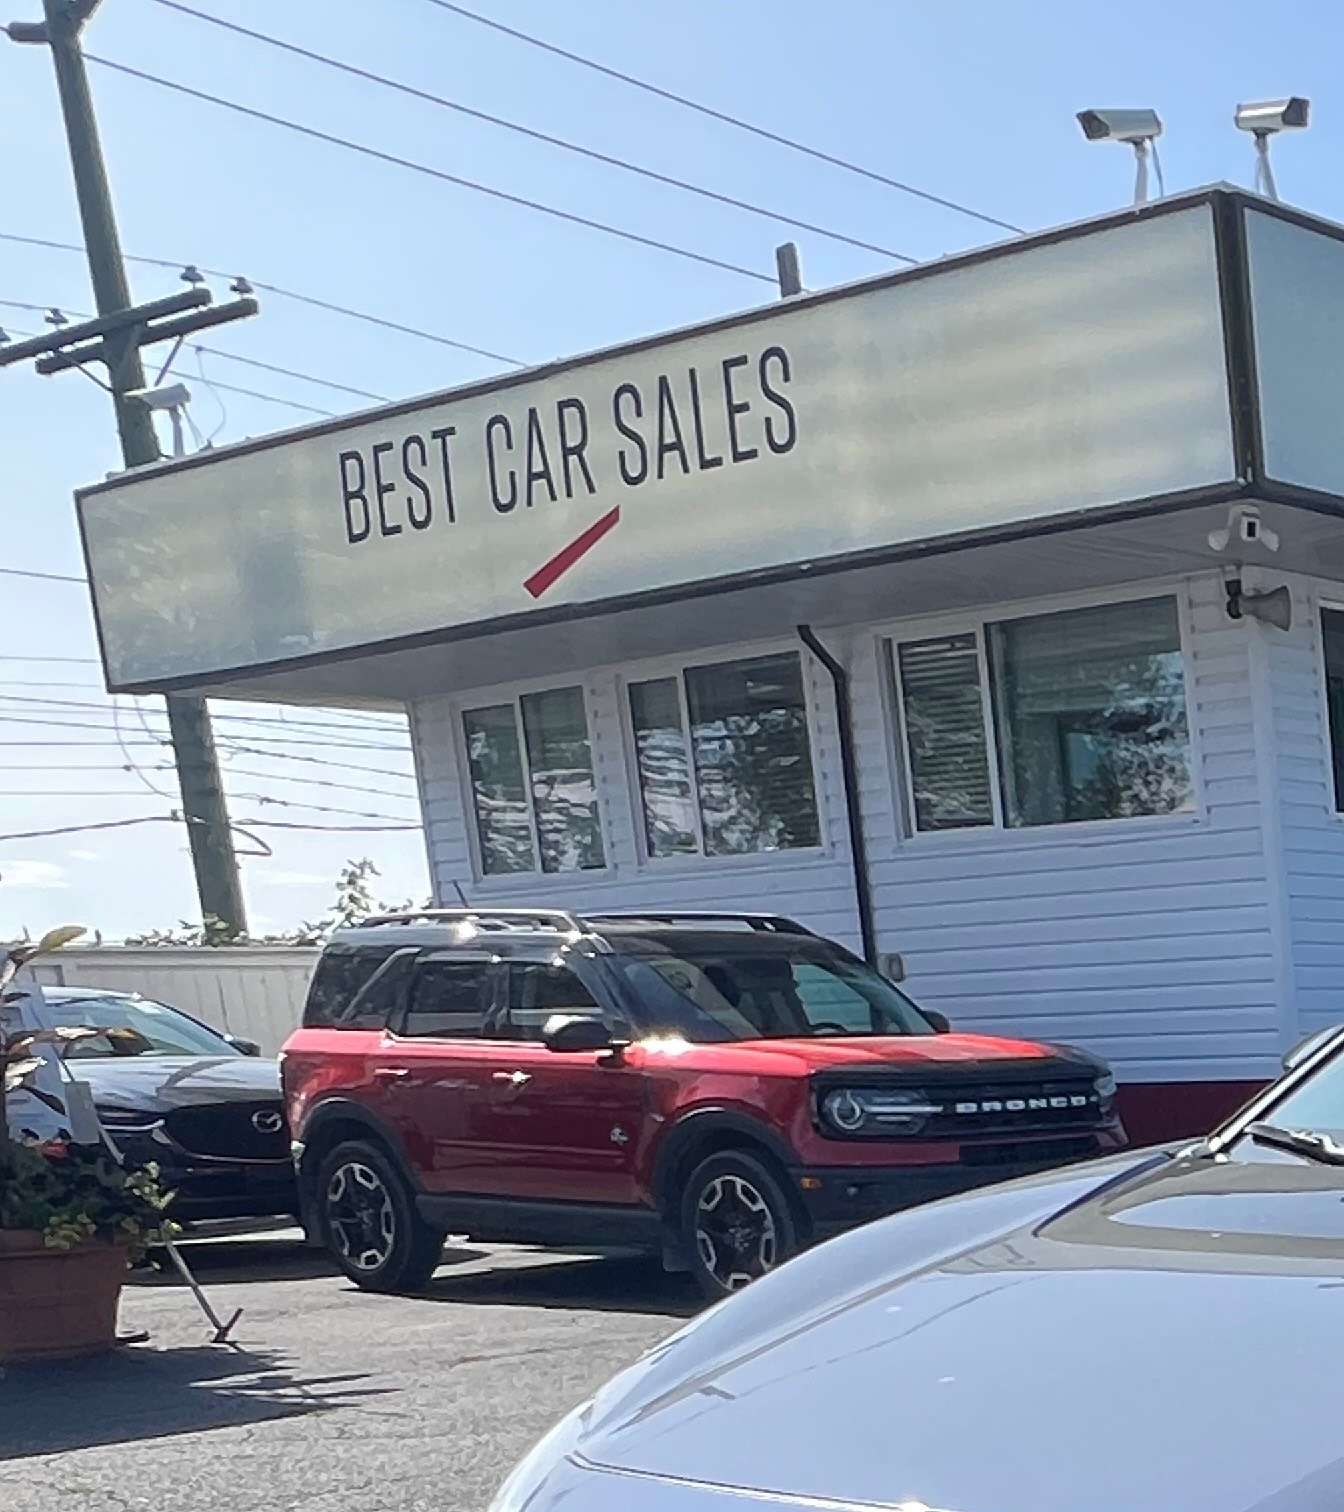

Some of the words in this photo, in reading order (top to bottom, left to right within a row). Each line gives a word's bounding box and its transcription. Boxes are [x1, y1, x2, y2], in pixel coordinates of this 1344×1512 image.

[339, 426, 457, 544] BEST
[486, 398, 597, 514] CAR
[613, 346, 797, 487] SALES
[955, 1096, 1087, 1114] BRONCO
